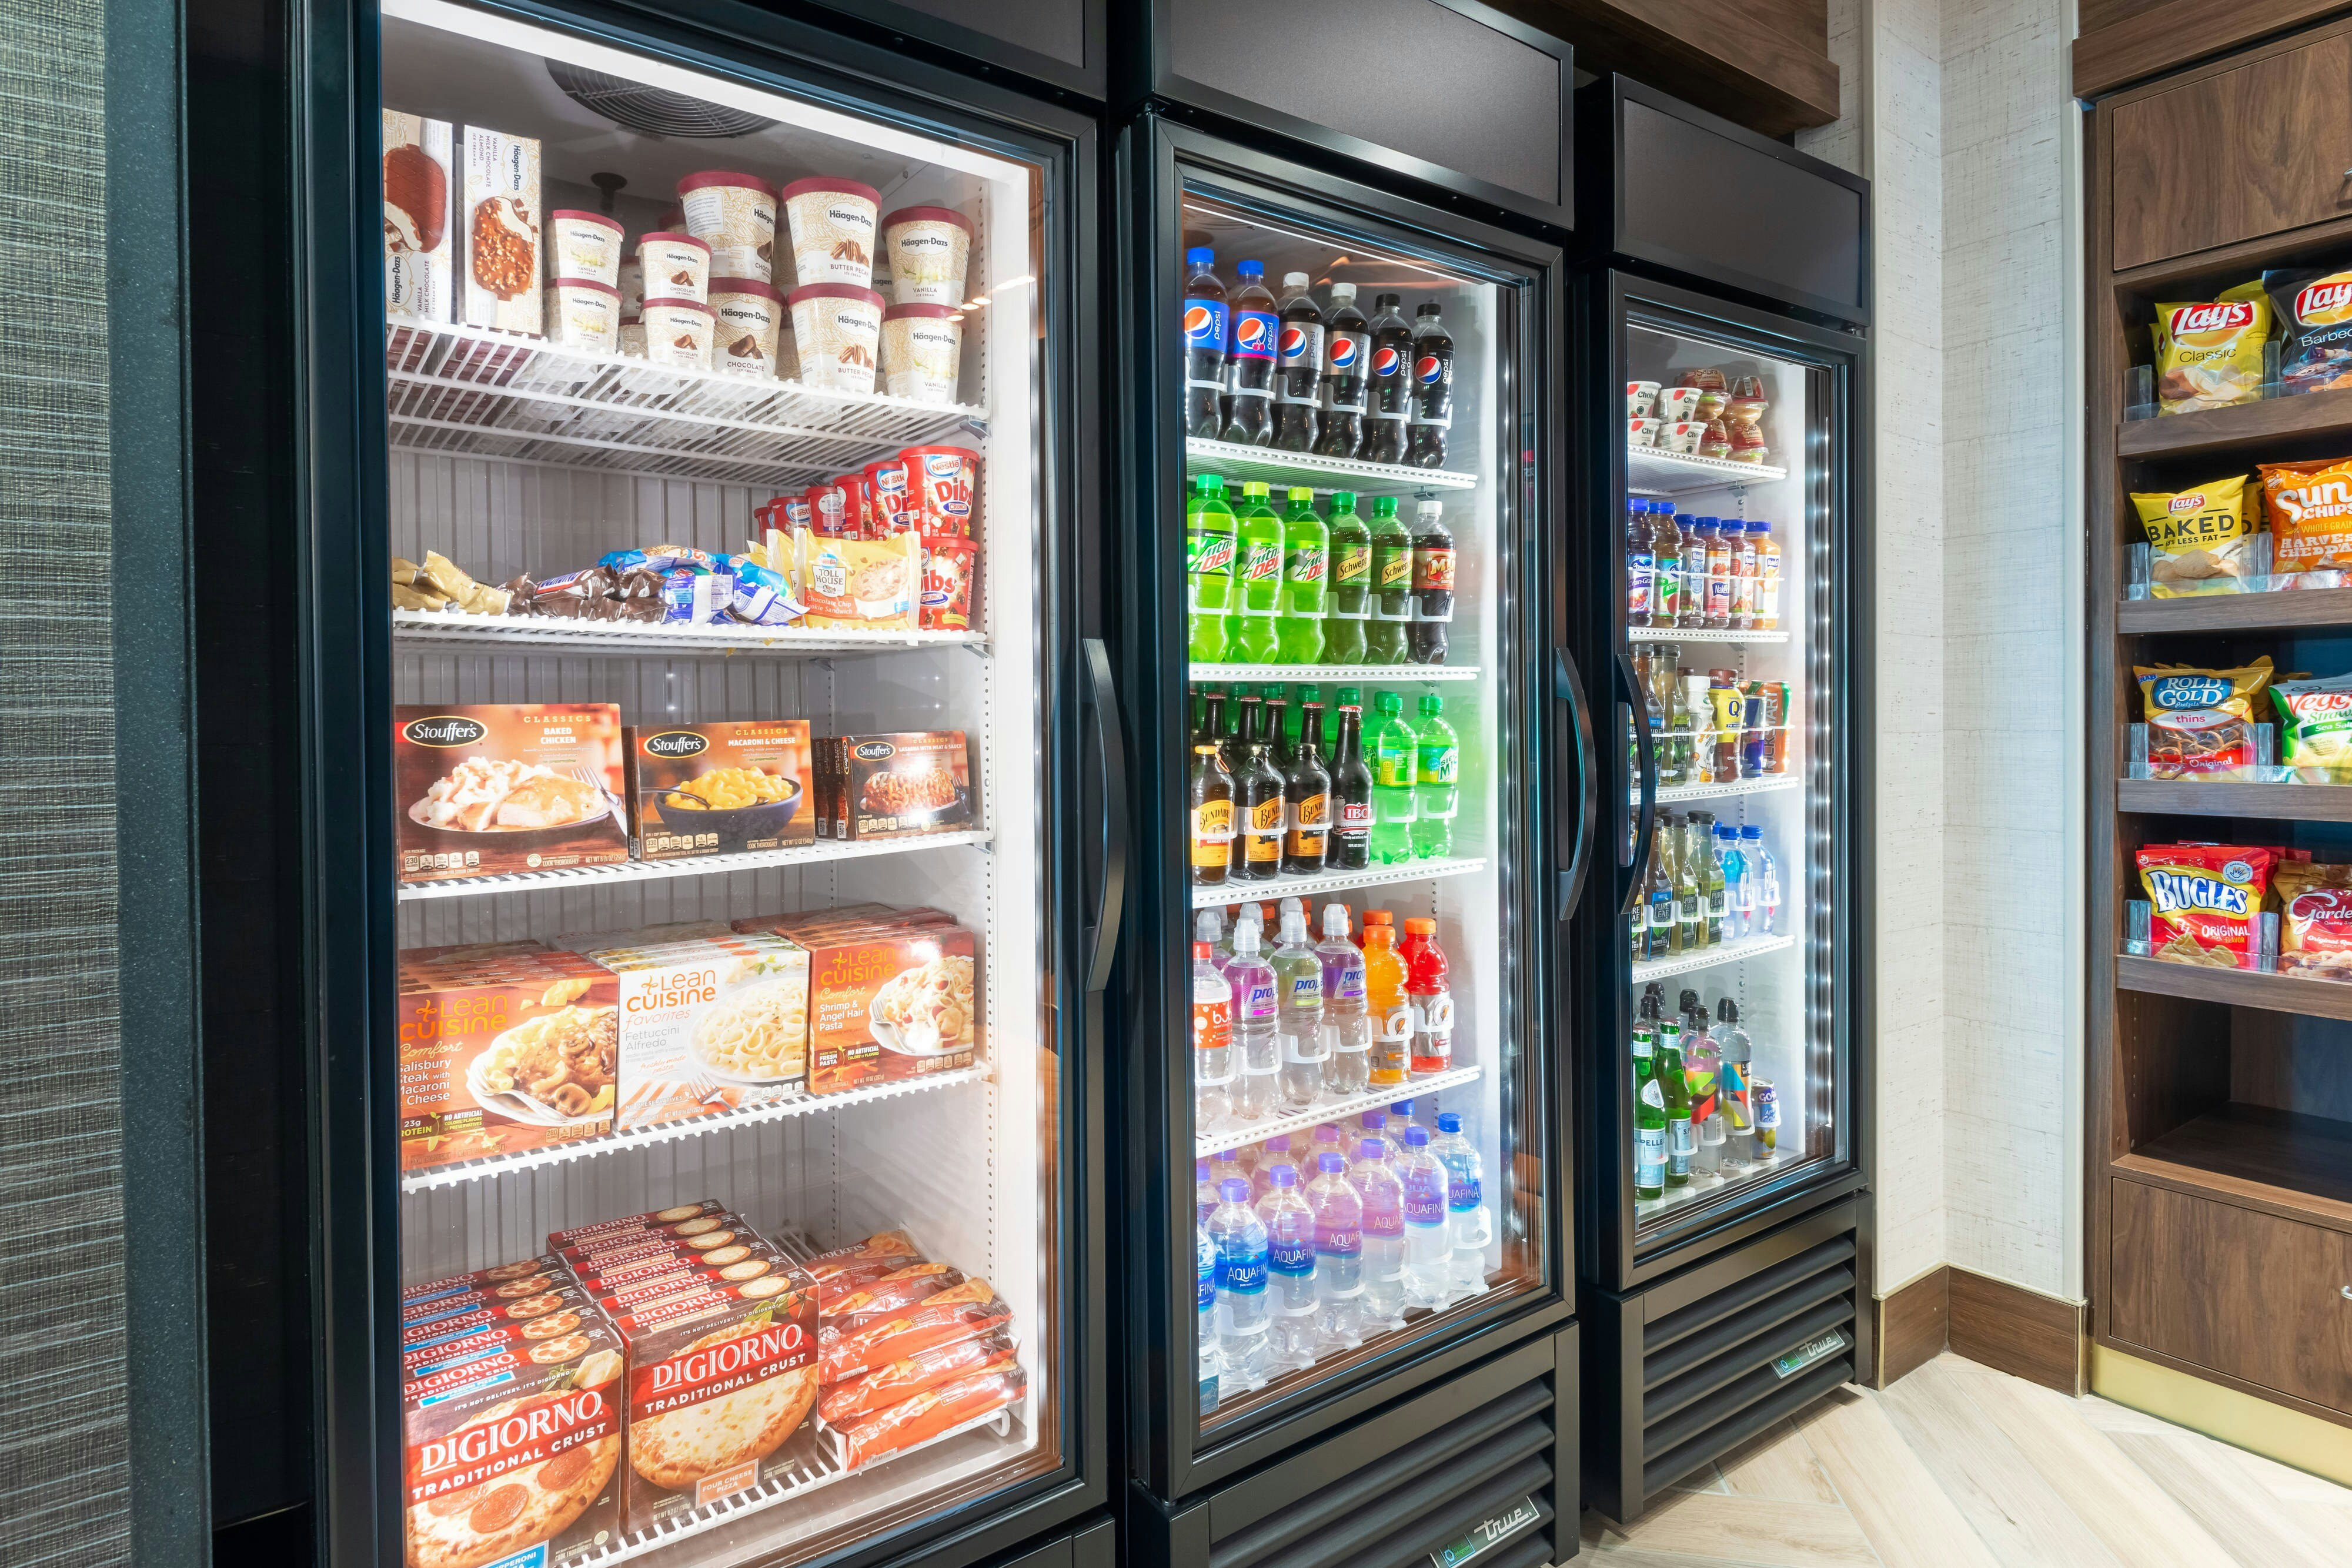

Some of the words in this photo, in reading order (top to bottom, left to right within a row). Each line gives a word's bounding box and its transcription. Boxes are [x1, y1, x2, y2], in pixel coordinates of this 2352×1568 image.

[2175, 302, 2246, 336] Lay's
[2180, 347, 2237, 363] Classic
[727, 362, 764, 372] CHOCOLATE
[838, 367, 860, 376] BUTTER
[934, 479, 973, 506] Dibs
[2170, 494, 2203, 511] Lay's
[2276, 481, 2352, 524] Sun
[2302, 503, 2352, 519] CHIPS
[2147, 515, 2234, 541] BAKED
[2301, 523, 2328, 533] WHOLE
[816, 575, 843, 585] HOUSE
[1715, 584, 1729, 594] Naked
[807, 595, 836, 606] Chocolate
[824, 606, 853, 614] Sandwich
[2165, 677, 2221, 690] ROLD
[2158, 689, 2223, 706] GOLD
[2176, 715, 2205, 723] thins
[413, 723, 477, 741] Stouffer's
[541, 736, 576, 744] CHICKEN
[653, 737, 701, 753] Stouffer's
[860, 745, 890, 757] Stouffer's
[2189, 756, 2234, 768] Original
[1347, 808, 1369, 819] IBC
[1712, 891, 1723, 900] PURE
[2146, 870, 2248, 914] BUGLES
[1655, 902, 1669, 910] PURE
[1684, 895, 1696, 904] PURE
[2201, 925, 2250, 937] ORIGINAL
[2307, 935, 2338, 944] Original
[849, 947, 895, 967] Lean
[661, 969, 716, 991] Lean
[820, 986, 866, 1001] Comfort
[440, 995, 507, 1017] Lean
[820, 1002, 850, 1013] Shrimp
[623, 1009, 691, 1032] favorites
[820, 1012, 844, 1022] Angel
[847, 1008, 864, 1018] Hair
[626, 1025, 680, 1041] Fettuccini
[820, 1022, 843, 1031] Pasta
[400, 1041, 463, 1058] Comfort
[626, 1038, 667, 1052] Alfredo
[856, 1045, 879, 1054] ARTIFICIAL
[666, 1055, 687, 1064] made
[433, 1071, 450, 1080] with
[407, 1092, 450, 1106] Cheese
[454, 1109, 483, 1120] ARTIFICIAL
[449, 1122, 482, 1130] PRESERVATIVES
[1404, 1201, 1445, 1216] AQUAFINA
[706, 1318, 735, 1329] DELIVERY.
[1799, 1336, 1837, 1357] true
[760, 1353, 806, 1378] CRUST
[455, 1403, 467, 1412] IT'S
[470, 1398, 484, 1407] NOT
[486, 1387, 522, 1403] DELIVERY.
[523, 1382, 536, 1390] IT'S
[413, 1449, 543, 1500] TRADITIONAL
[552, 1422, 607, 1452] CRUST
[702, 1481, 723, 1493] FOUR
[724, 1469, 753, 1484] CHEESE
[717, 1482, 738, 1493] PIZZA
[555, 1553, 566, 1562] COOK
[566, 1543, 592, 1558] THOROUGHLY
